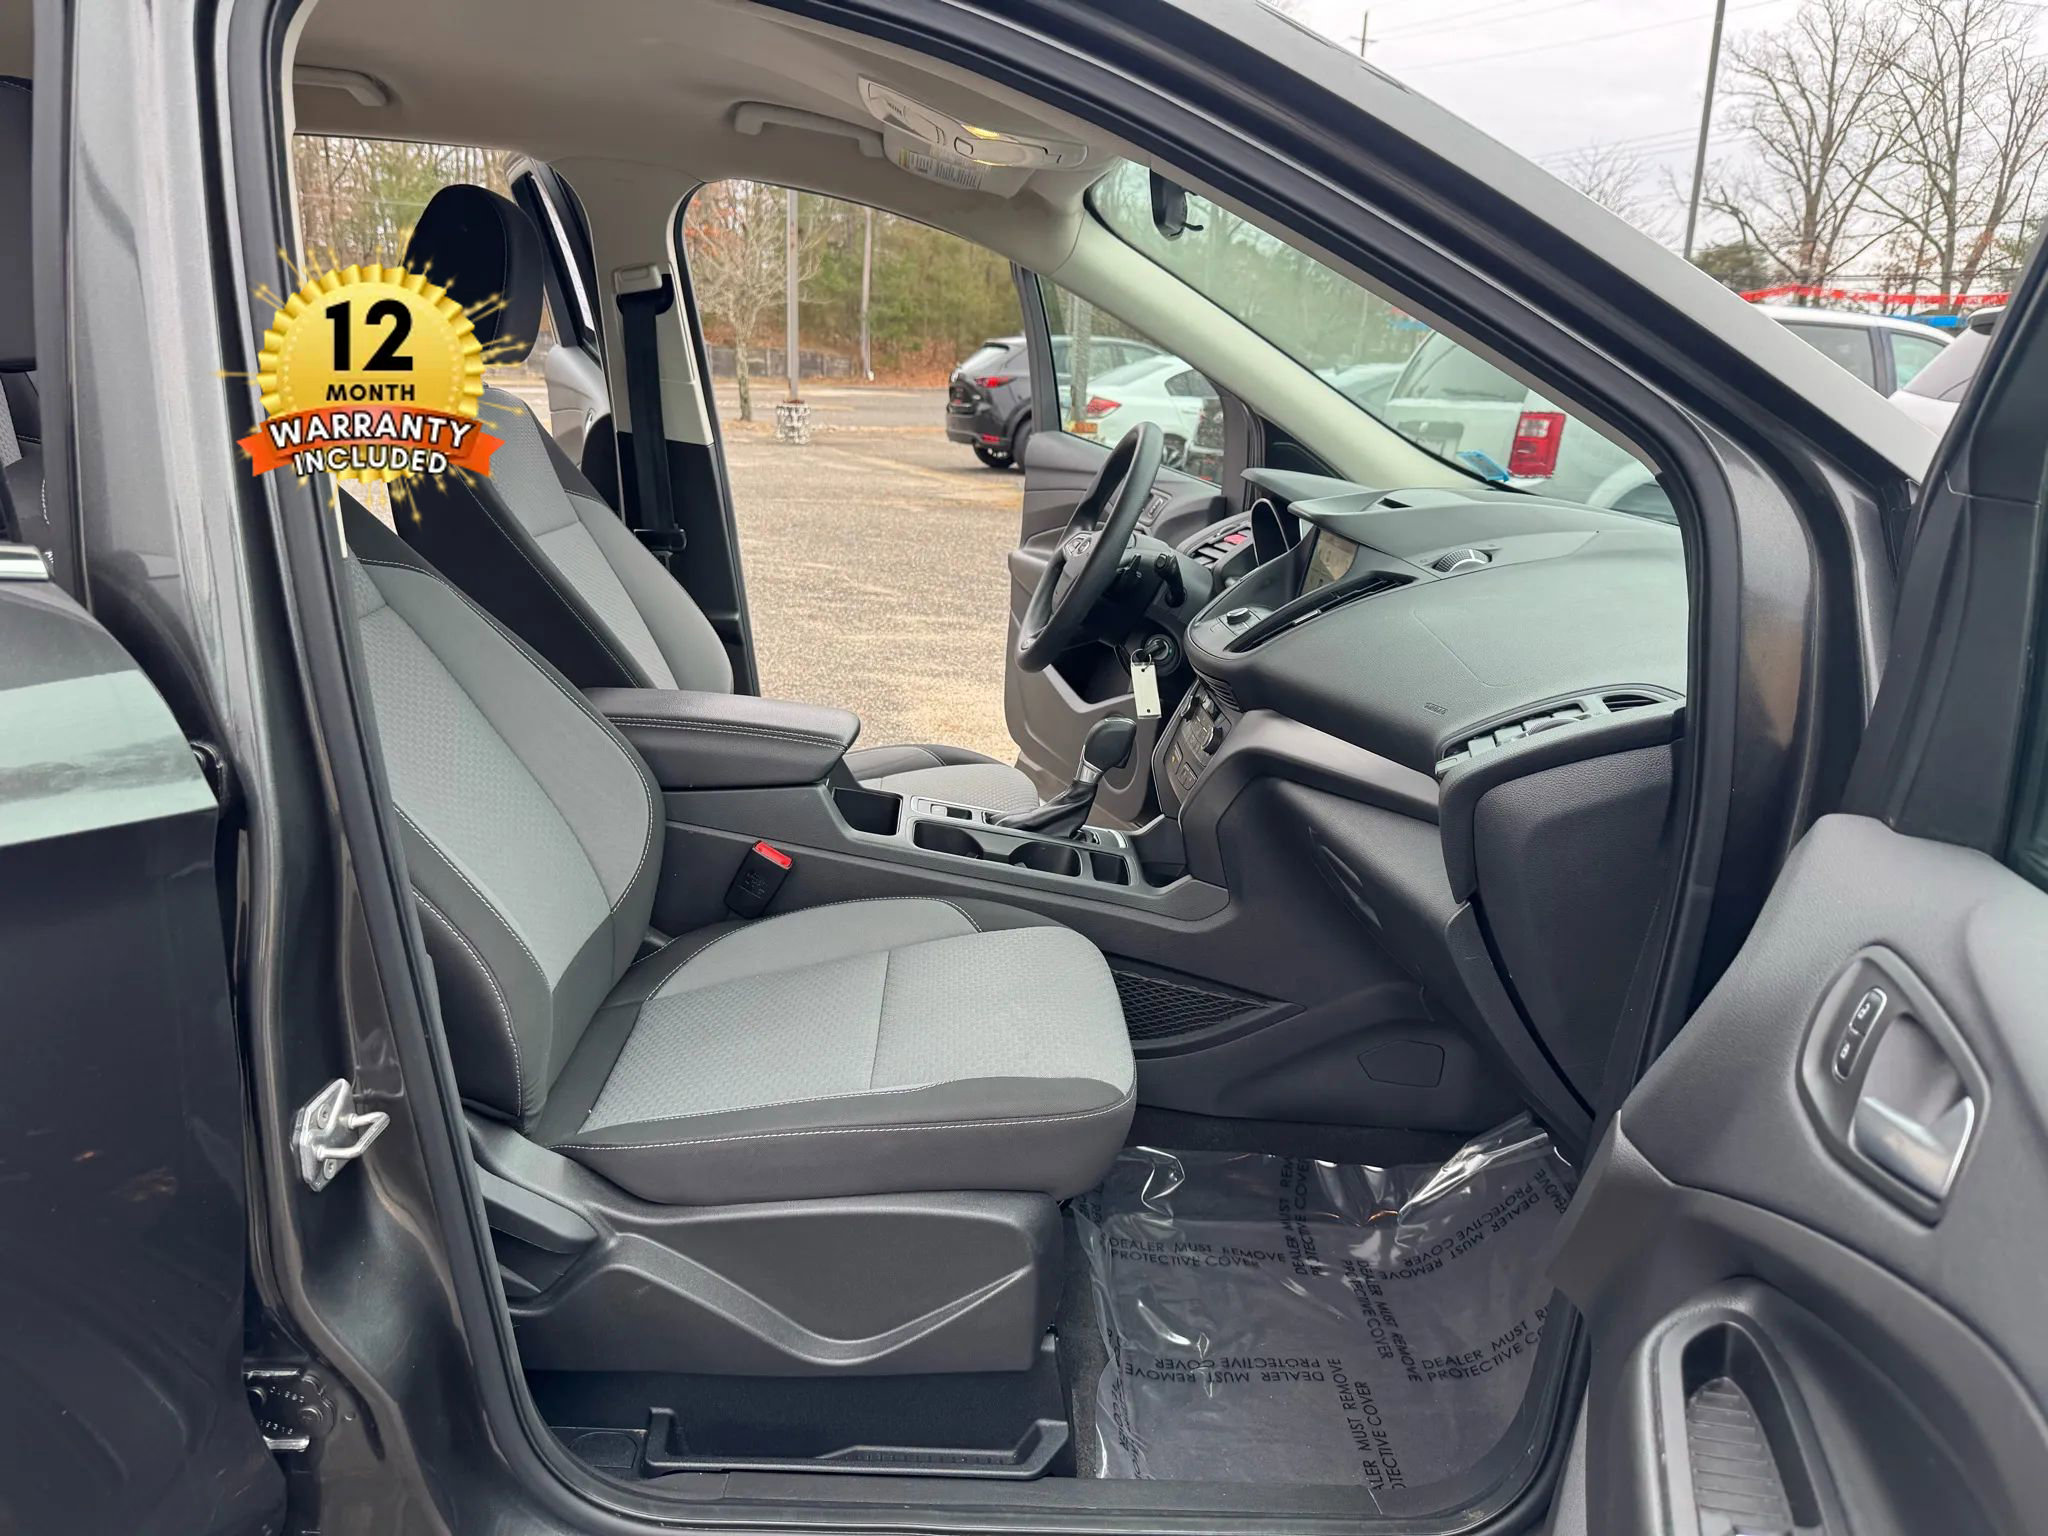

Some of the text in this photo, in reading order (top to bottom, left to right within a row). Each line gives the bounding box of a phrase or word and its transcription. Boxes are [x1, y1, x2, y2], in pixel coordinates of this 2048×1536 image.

[1279, 1198, 1294, 1231] MUST
[1403, 1180, 1534, 1267] PROTECTIVE COVER
[1109, 1237, 1164, 1251] DEALER
[1174, 1242, 1213, 1254] MUST
[1222, 1247, 1286, 1263] REMOVE
[1286, 1235, 1308, 1275] DEALER
[1381, 1193, 1540, 1280] DEALER MUST REMOVE
[1110, 1250, 1200, 1267] PROTECTIVE
[1357, 1260, 1422, 1382] DEALER MUST REMOVE
[1367, 1318, 1394, 1359] COVER
[1154, 1357, 1321, 1369] PROTECTIVE COVER
[1422, 1349, 1484, 1370] DEALER
[1491, 1320, 1529, 1351] MUST
[1427, 1342, 1524, 1382] PROTECTIVE
[1125, 1362, 1324, 1384] DEALER MUST REMOVE
[1328, 1358, 1358, 1411] REMOVE
[1354, 1381, 1382, 1427] COVER
[1347, 1416, 1372, 1451] MUST
